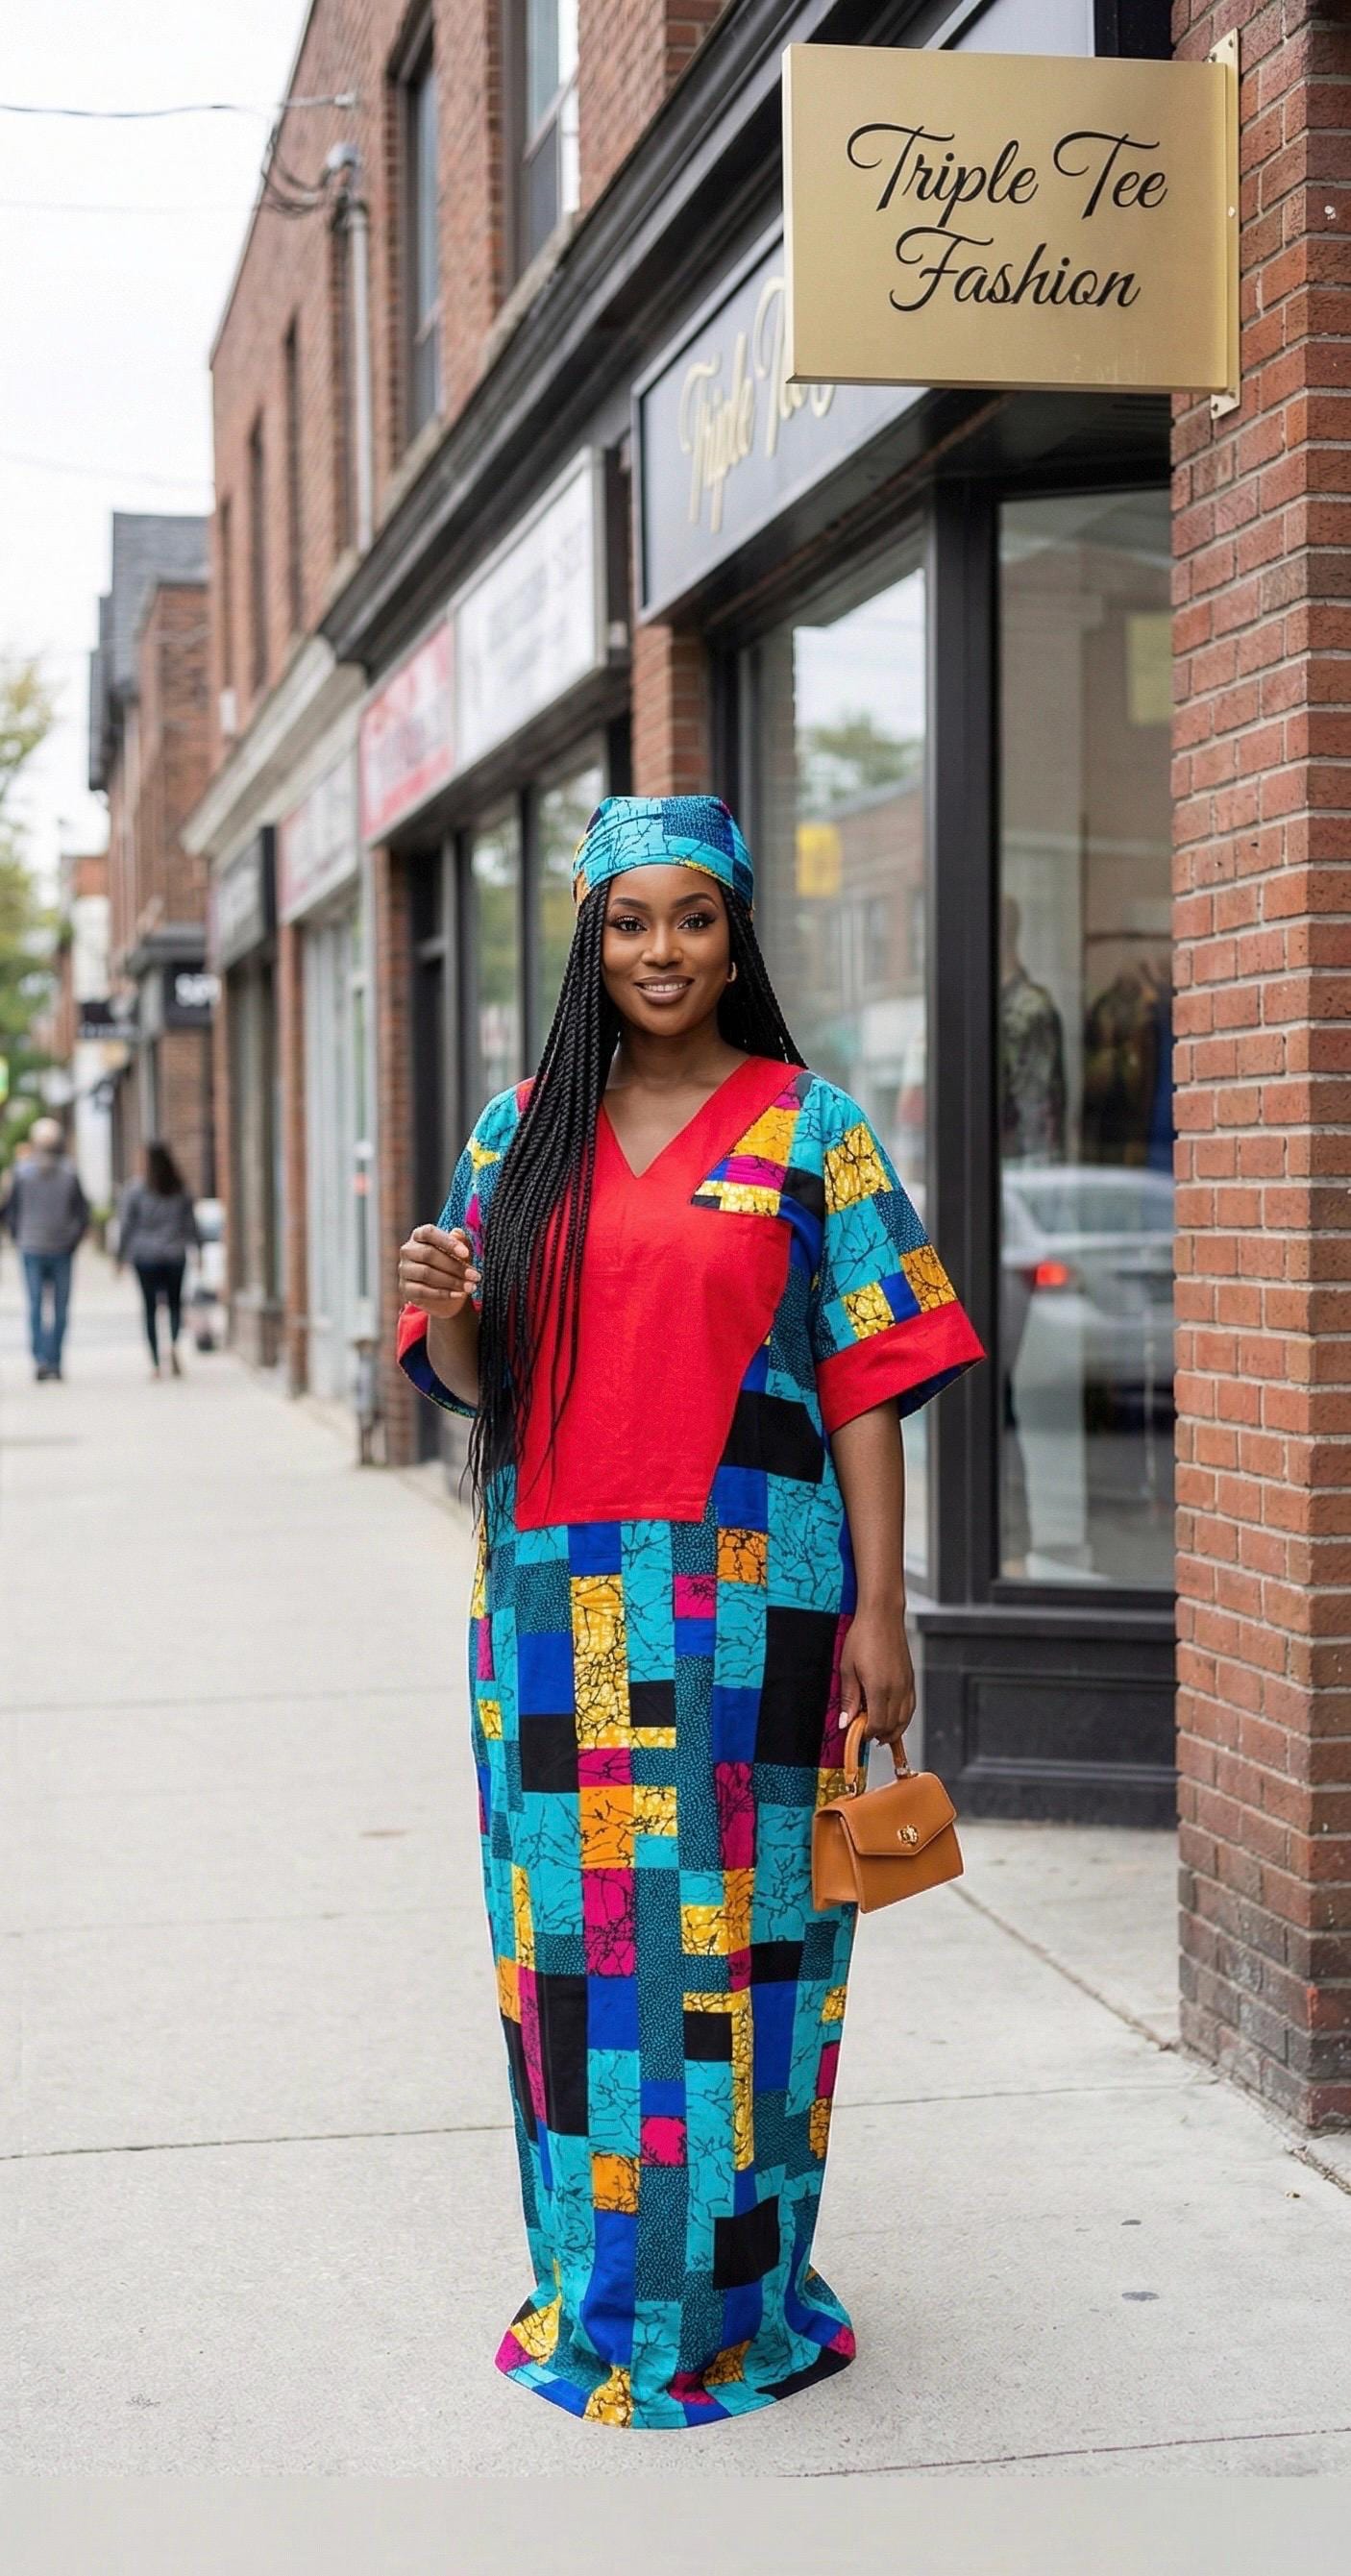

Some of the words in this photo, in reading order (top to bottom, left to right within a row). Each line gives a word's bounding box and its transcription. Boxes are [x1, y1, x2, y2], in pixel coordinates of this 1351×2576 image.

[847, 122, 1039, 228] Triple
[1052, 130, 1168, 220] Tee
[889, 226, 1142, 312] Fashion
